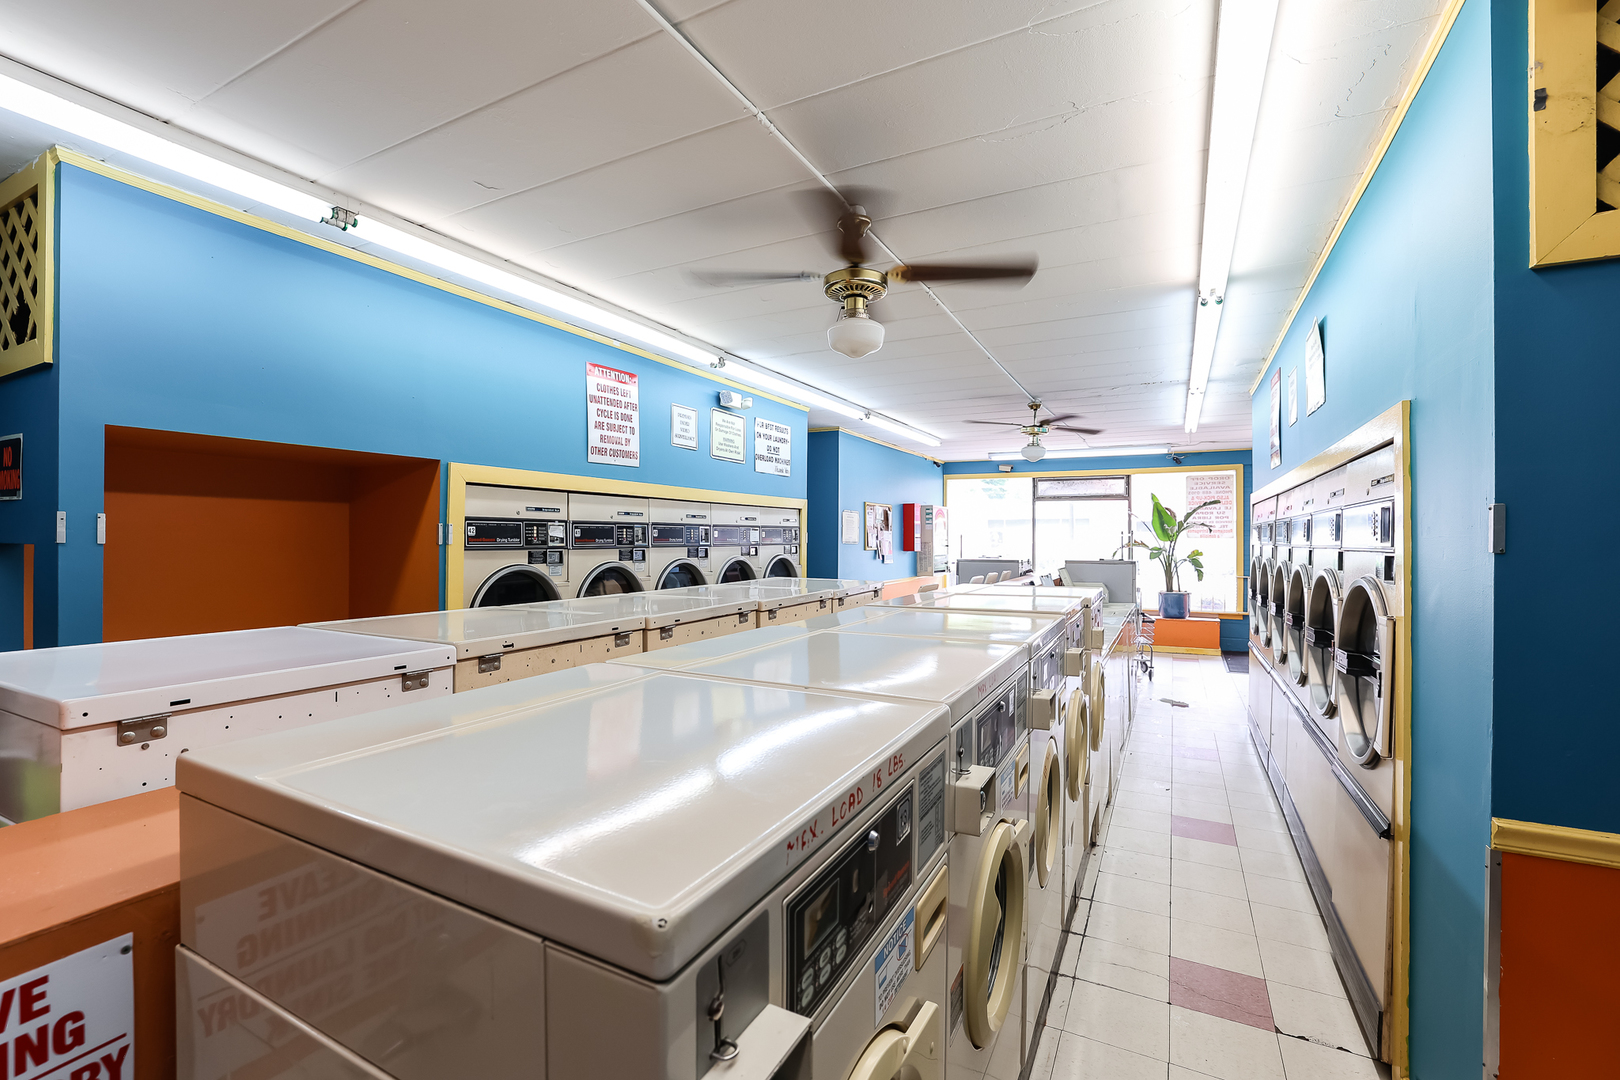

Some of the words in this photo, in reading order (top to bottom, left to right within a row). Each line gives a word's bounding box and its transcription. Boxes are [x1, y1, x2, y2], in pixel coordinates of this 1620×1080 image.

[596, 382, 620, 396] CLOTHES
[620, 388, 632, 398] LEFT
[589, 394, 622, 409] UNATTENDED
[624, 401, 638, 412] AFTER
[596, 408, 613, 420] CYCLE
[614, 411, 620, 420] IS
[620, 412, 633, 424] DONE
[594, 420, 605, 430] ARE
[606, 422, 628, 434] SUBJECT
[629, 426, 636, 436] TO
[600, 434, 624, 446] REMOVAL
[624, 438, 631, 446] BY
[3, 446, 12, 467] NO
[590, 446, 608, 456] OTHER
[608, 448, 638, 460] CUSTOMERS
[755, 454, 774, 463] OVERLOAD
[832, 786, 863, 827] LOAD
[884, 919, 907, 959] NOTICE
